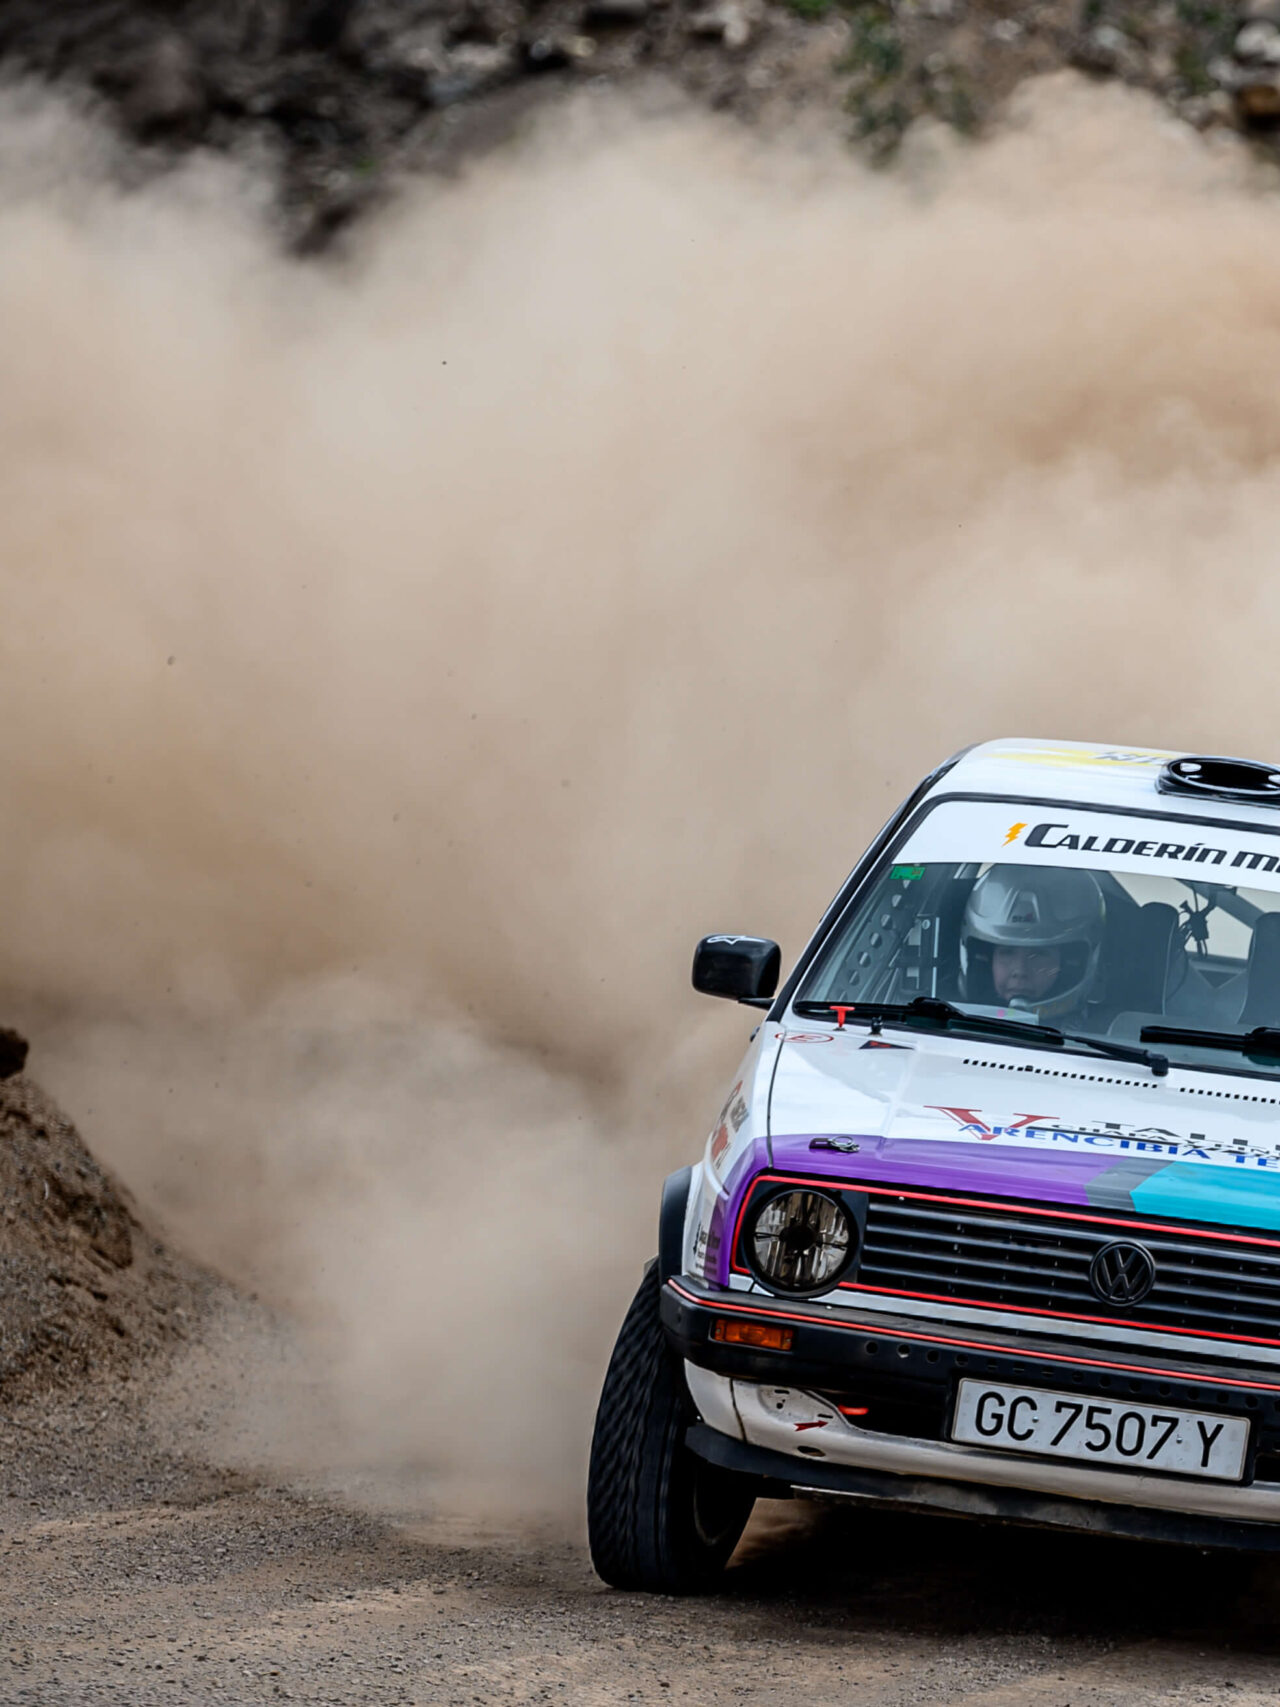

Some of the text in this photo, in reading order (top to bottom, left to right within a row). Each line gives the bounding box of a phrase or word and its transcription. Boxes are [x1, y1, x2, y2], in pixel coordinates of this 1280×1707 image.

[959, 1123, 1211, 1160] ARENCIBIA
[975, 1391, 1225, 1468] GC 7507 Y
